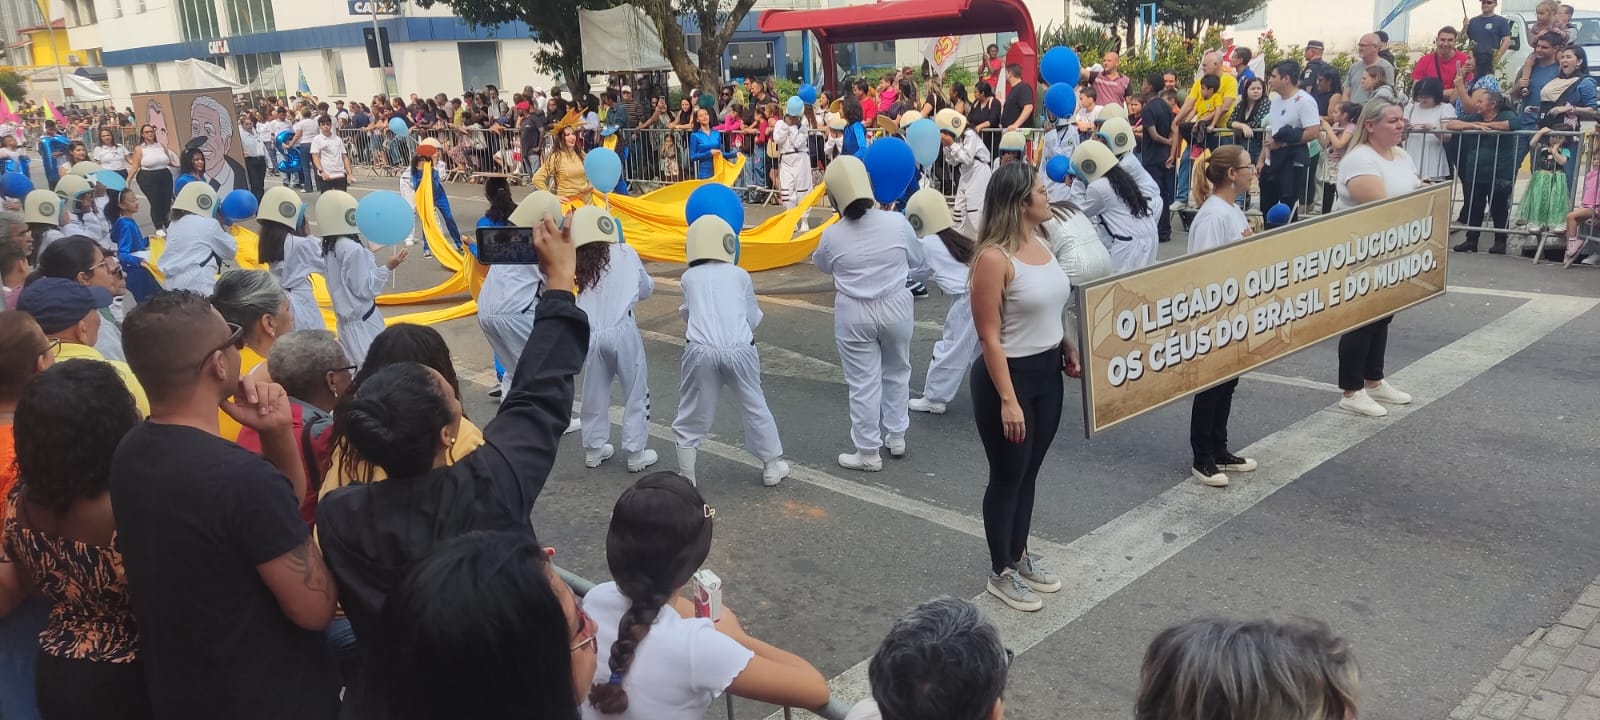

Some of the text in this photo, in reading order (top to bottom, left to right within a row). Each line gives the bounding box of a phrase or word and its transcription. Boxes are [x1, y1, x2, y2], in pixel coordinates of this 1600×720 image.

[1108, 249, 1437, 386] OS CÉUS DO BRASIL E DO MUNDO.
[1116, 216, 1433, 341] O LEGADO QUE REVOLUCIONOU
